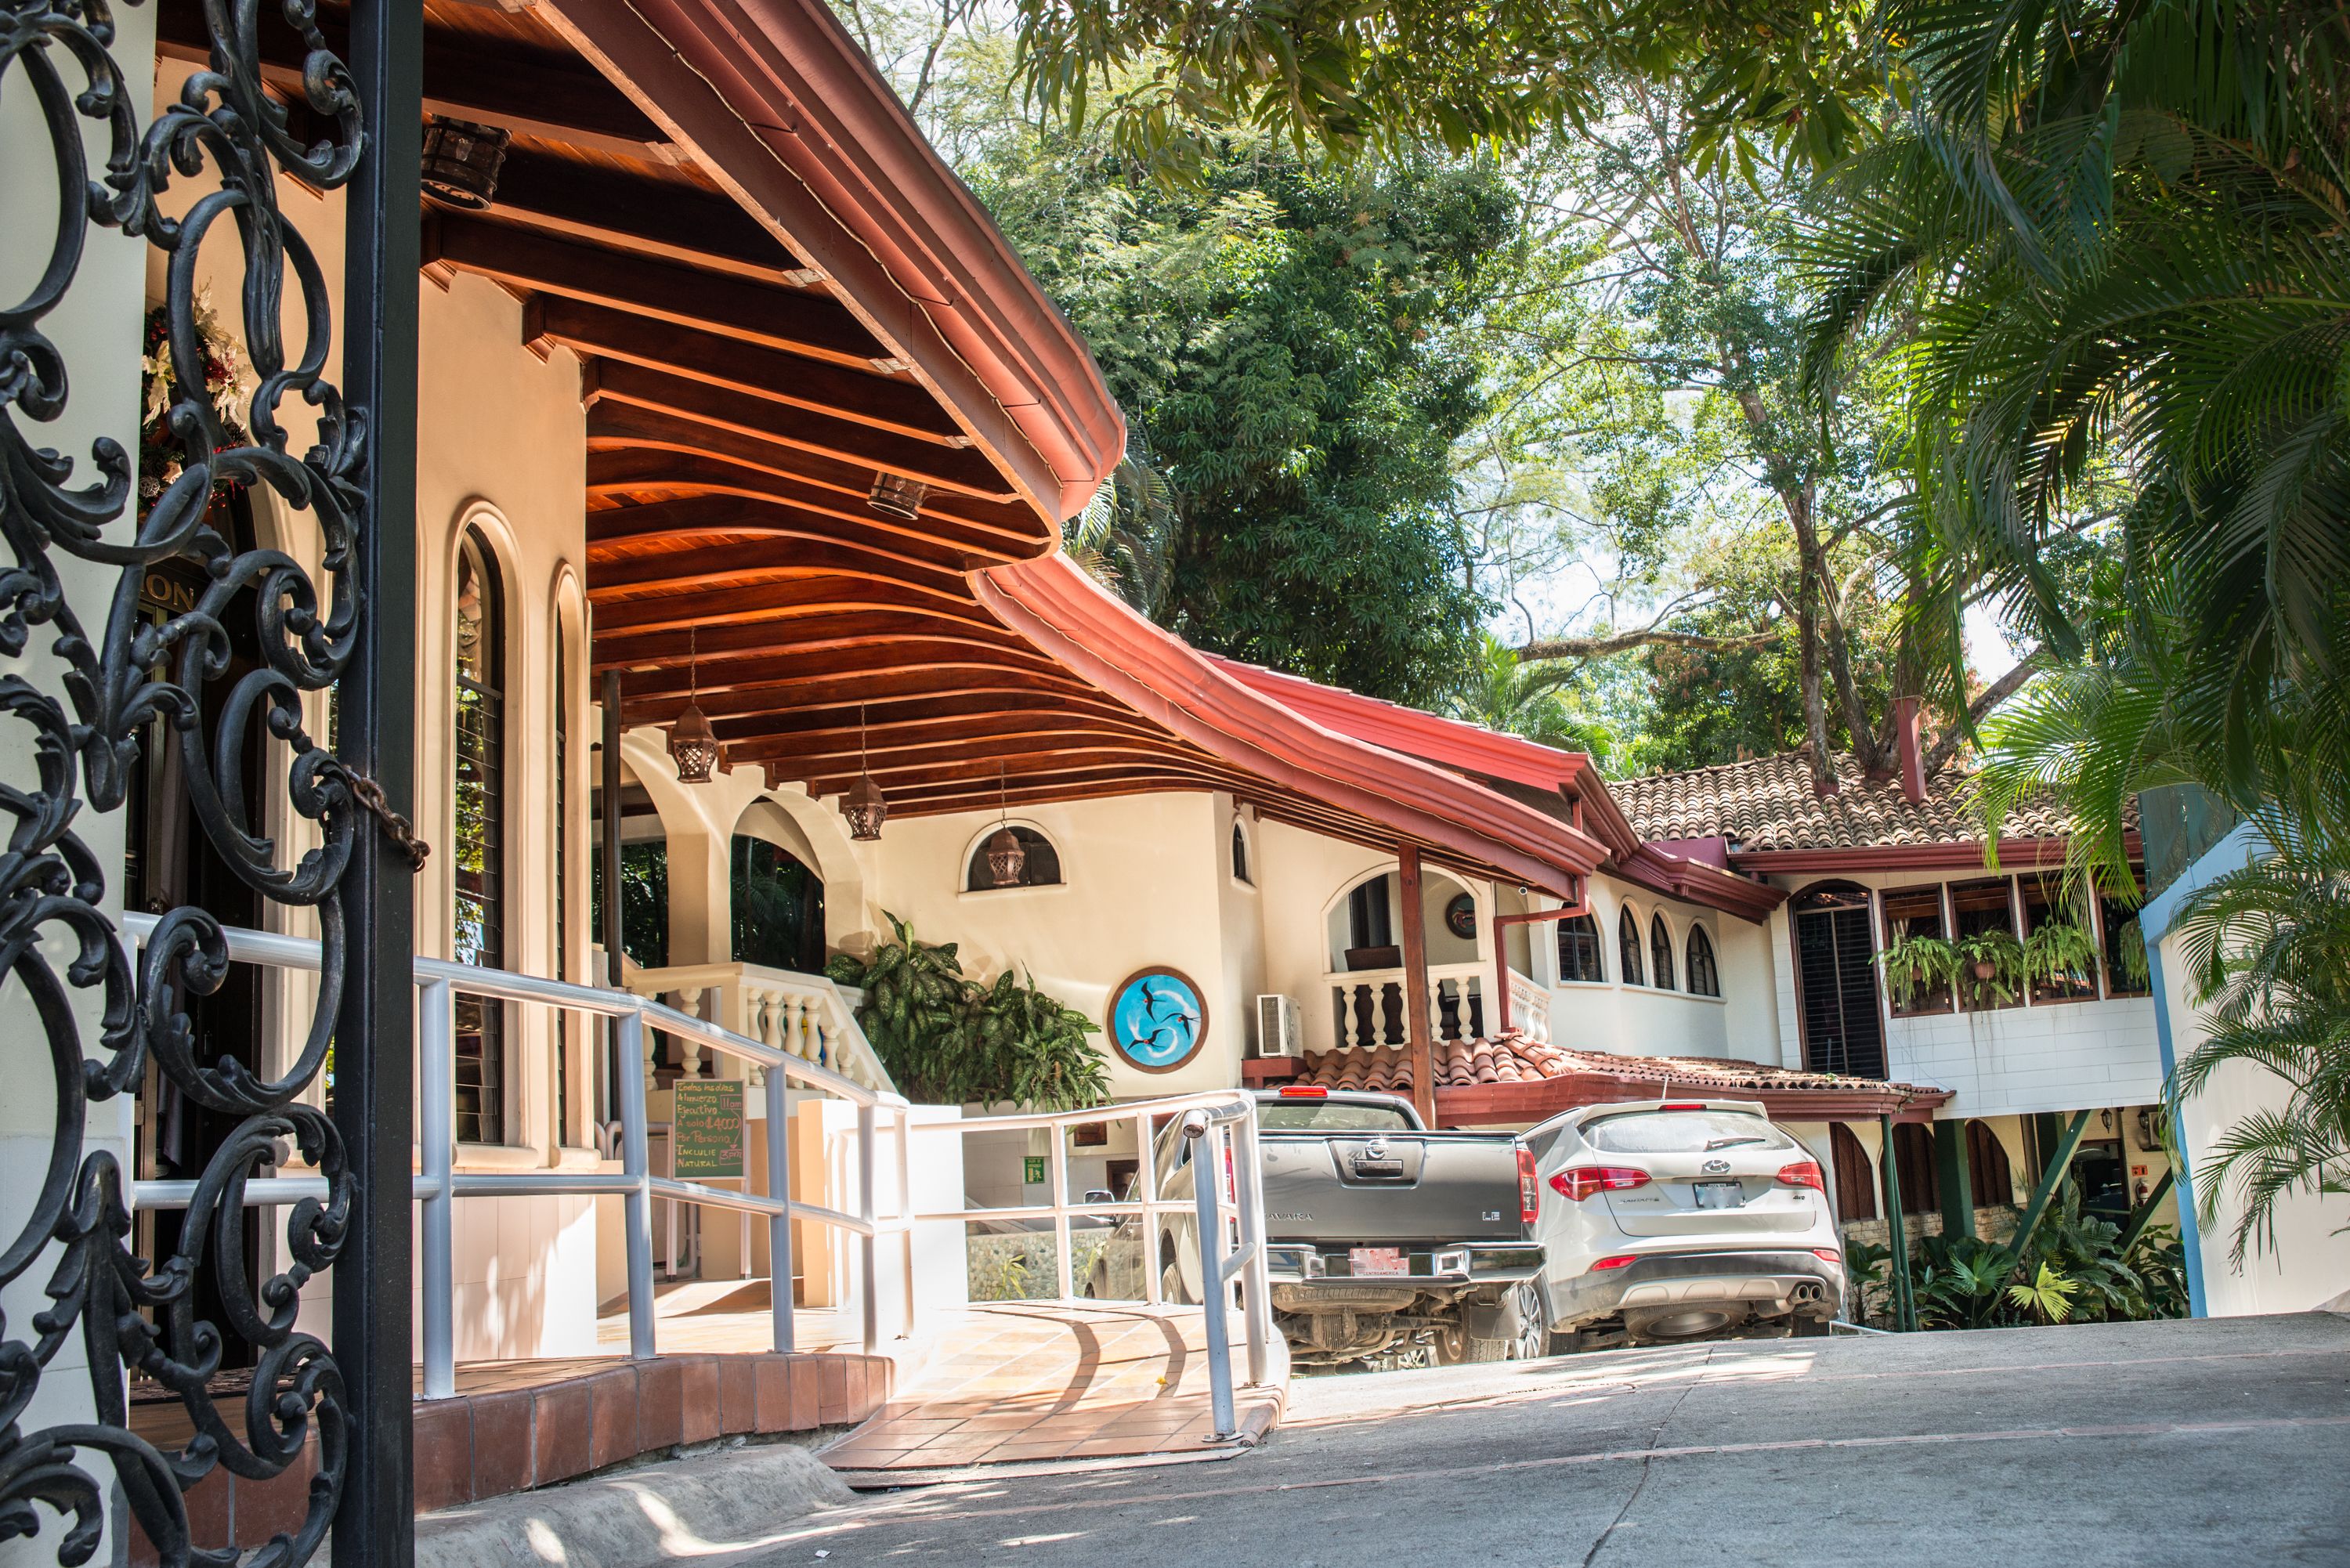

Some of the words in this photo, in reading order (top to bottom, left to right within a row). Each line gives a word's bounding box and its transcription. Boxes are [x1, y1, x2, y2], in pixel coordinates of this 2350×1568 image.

[677, 1093, 717, 1104] Almuerzo
[686, 1118, 704, 1127] solo
[677, 1159, 718, 1168] NATURAL
